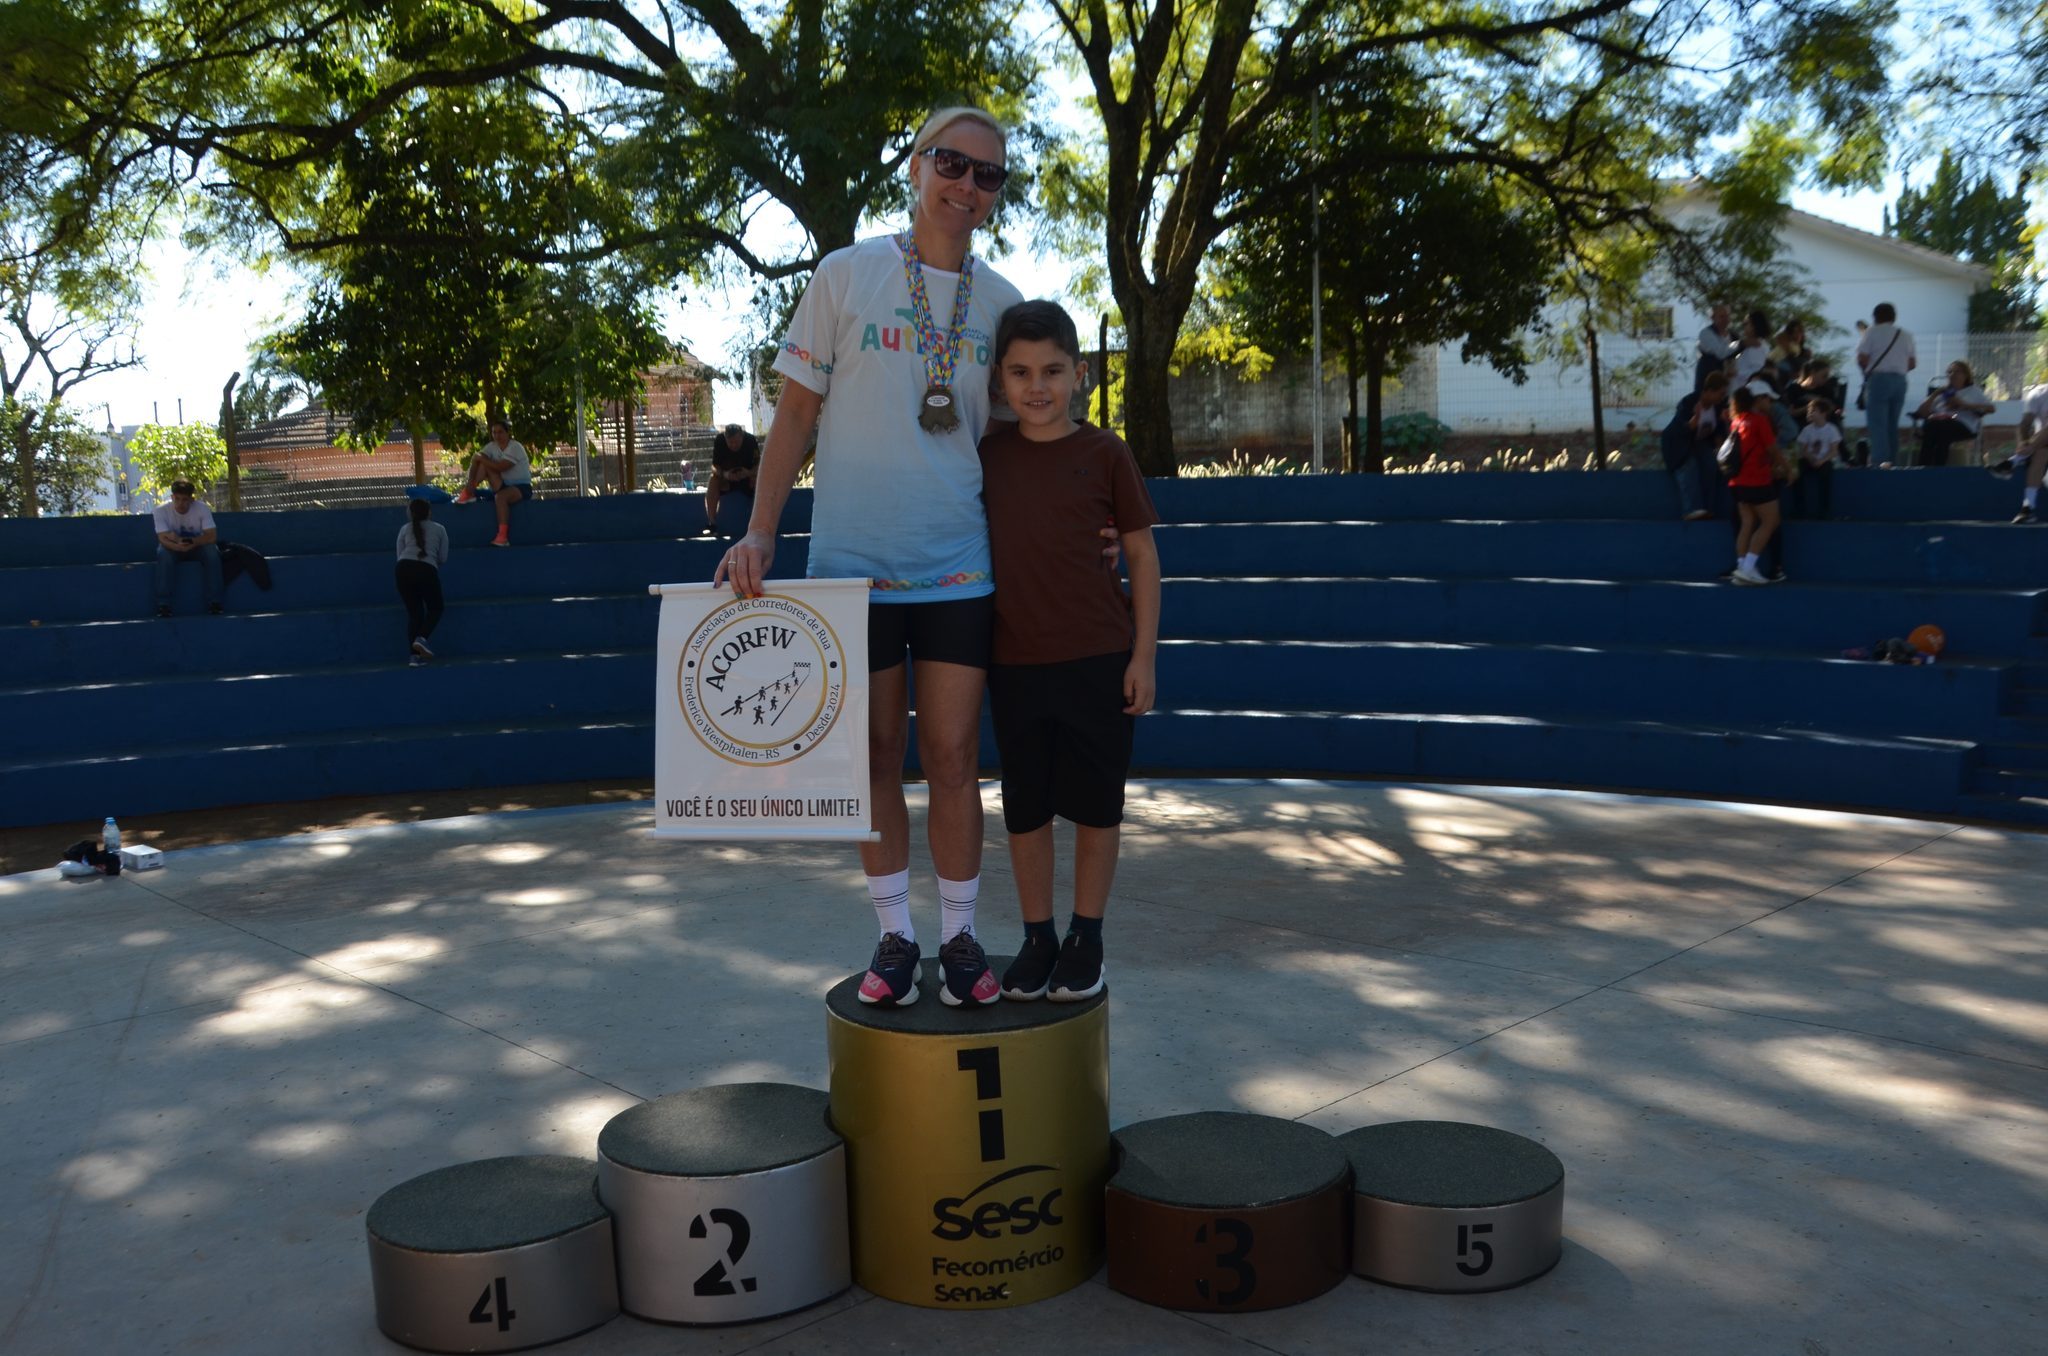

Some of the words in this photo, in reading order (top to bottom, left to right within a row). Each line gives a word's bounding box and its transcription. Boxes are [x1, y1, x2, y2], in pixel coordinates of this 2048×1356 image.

[691, 608, 736, 653] Associação
[737, 602, 750, 612] de
[751, 598, 808, 621] Corredores
[806, 617, 819, 631] de
[816, 628, 831, 651] Rua
[705, 626, 797, 692] ACORFW
[684, 676, 704, 726] Frederico
[805, 713, 832, 741] Desde
[826, 684, 841, 712] 2024
[666, 796, 701, 818] VOCÊ
[705, 796, 713, 818] É
[717, 799, 727, 818] O
[730, 799, 757, 818] SEU
[761, 795, 803, 818] ÚNICO
[807, 798, 861, 817] LIMITE!
[957, 1046, 1005, 1162] 1
[689, 1208, 758, 1297] 2
[932, 1246, 1064, 1277] Fecomércio
[1195, 1218, 1256, 1306] 3
[1455, 1223, 1494, 1277] 5
[468, 1277, 516, 1332] 4
[934, 1282, 1009, 1302] Senac
